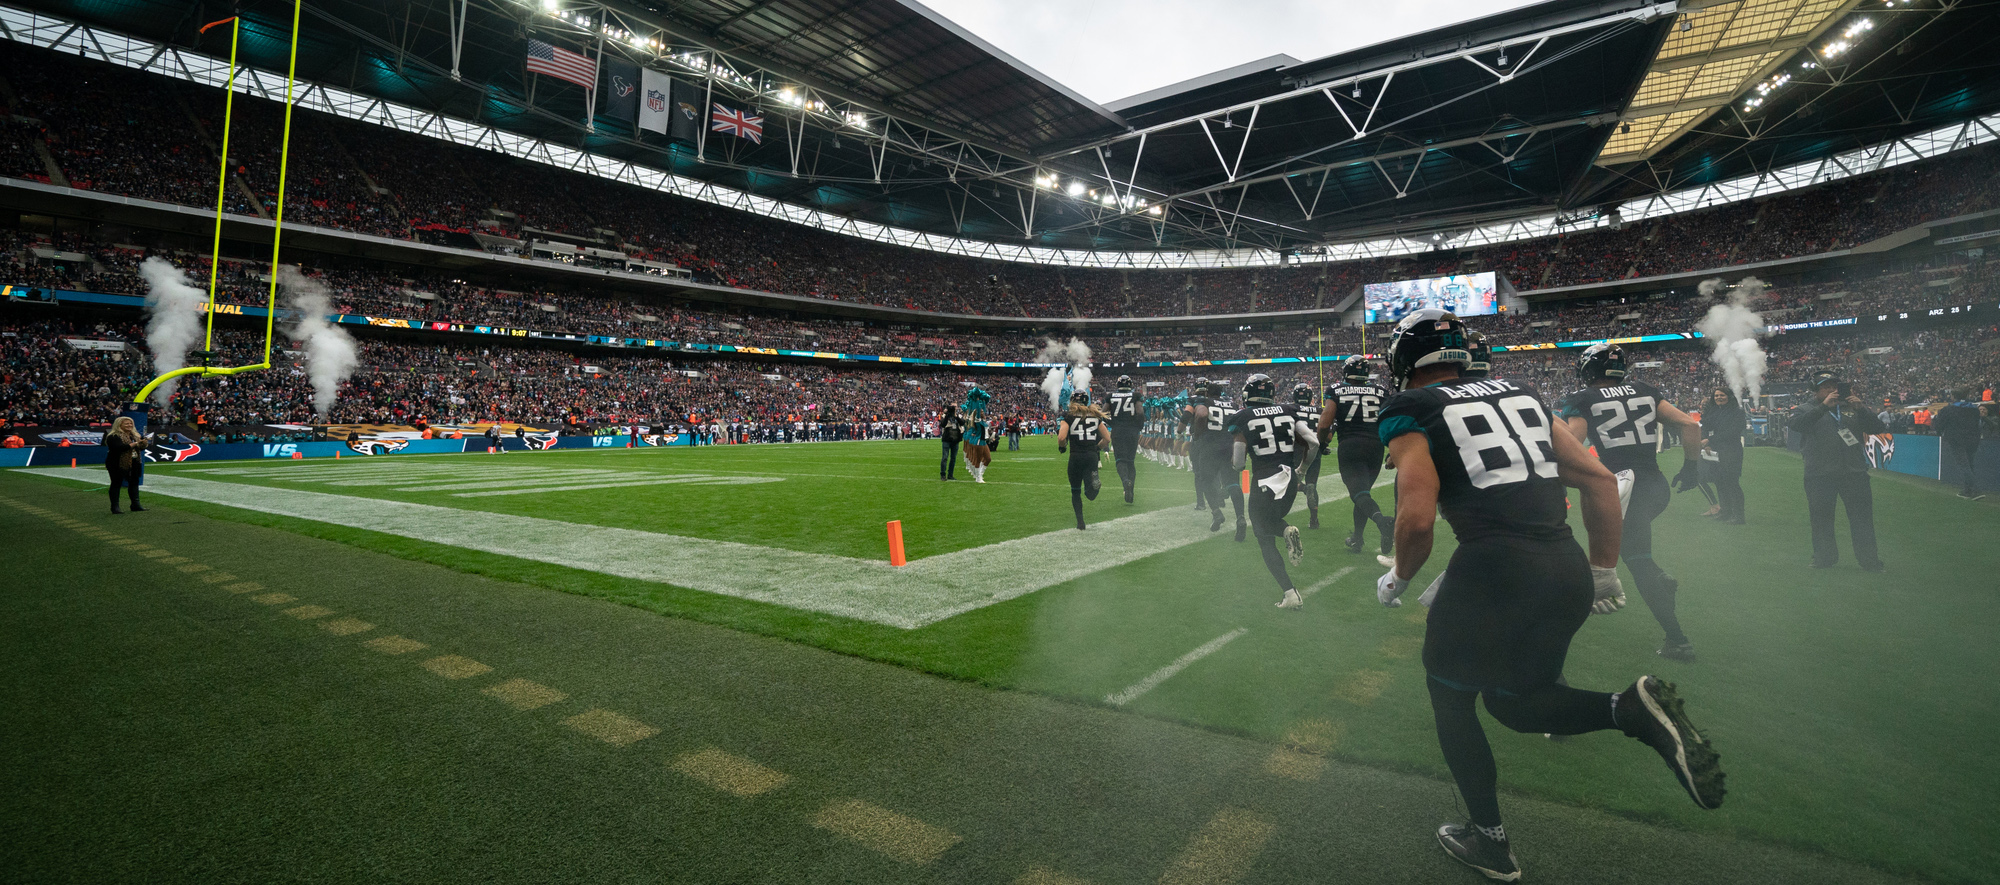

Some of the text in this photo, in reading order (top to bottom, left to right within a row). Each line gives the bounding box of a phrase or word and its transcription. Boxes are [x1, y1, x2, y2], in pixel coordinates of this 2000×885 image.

[649, 97, 663, 110] NFL
[512, 329, 527, 337] 9:07
[1438, 351, 1468, 360] JAGUARS
[1335, 386, 1376, 396] RICHARDSON
[1600, 385, 1636, 398] DAVIS
[1110, 397, 1135, 416] 74
[1253, 406, 1284, 417] OZIGBO
[1300, 405, 1317, 413] SMITH
[1339, 395, 1380, 422] 76
[1070, 417, 1099, 441] 42
[1590, 396, 1657, 449] 22
[592, 436, 613, 447] VS
[1247, 415, 1296, 456] 33
[1442, 395, 1559, 489] 88
[263, 443, 297, 457] VS
